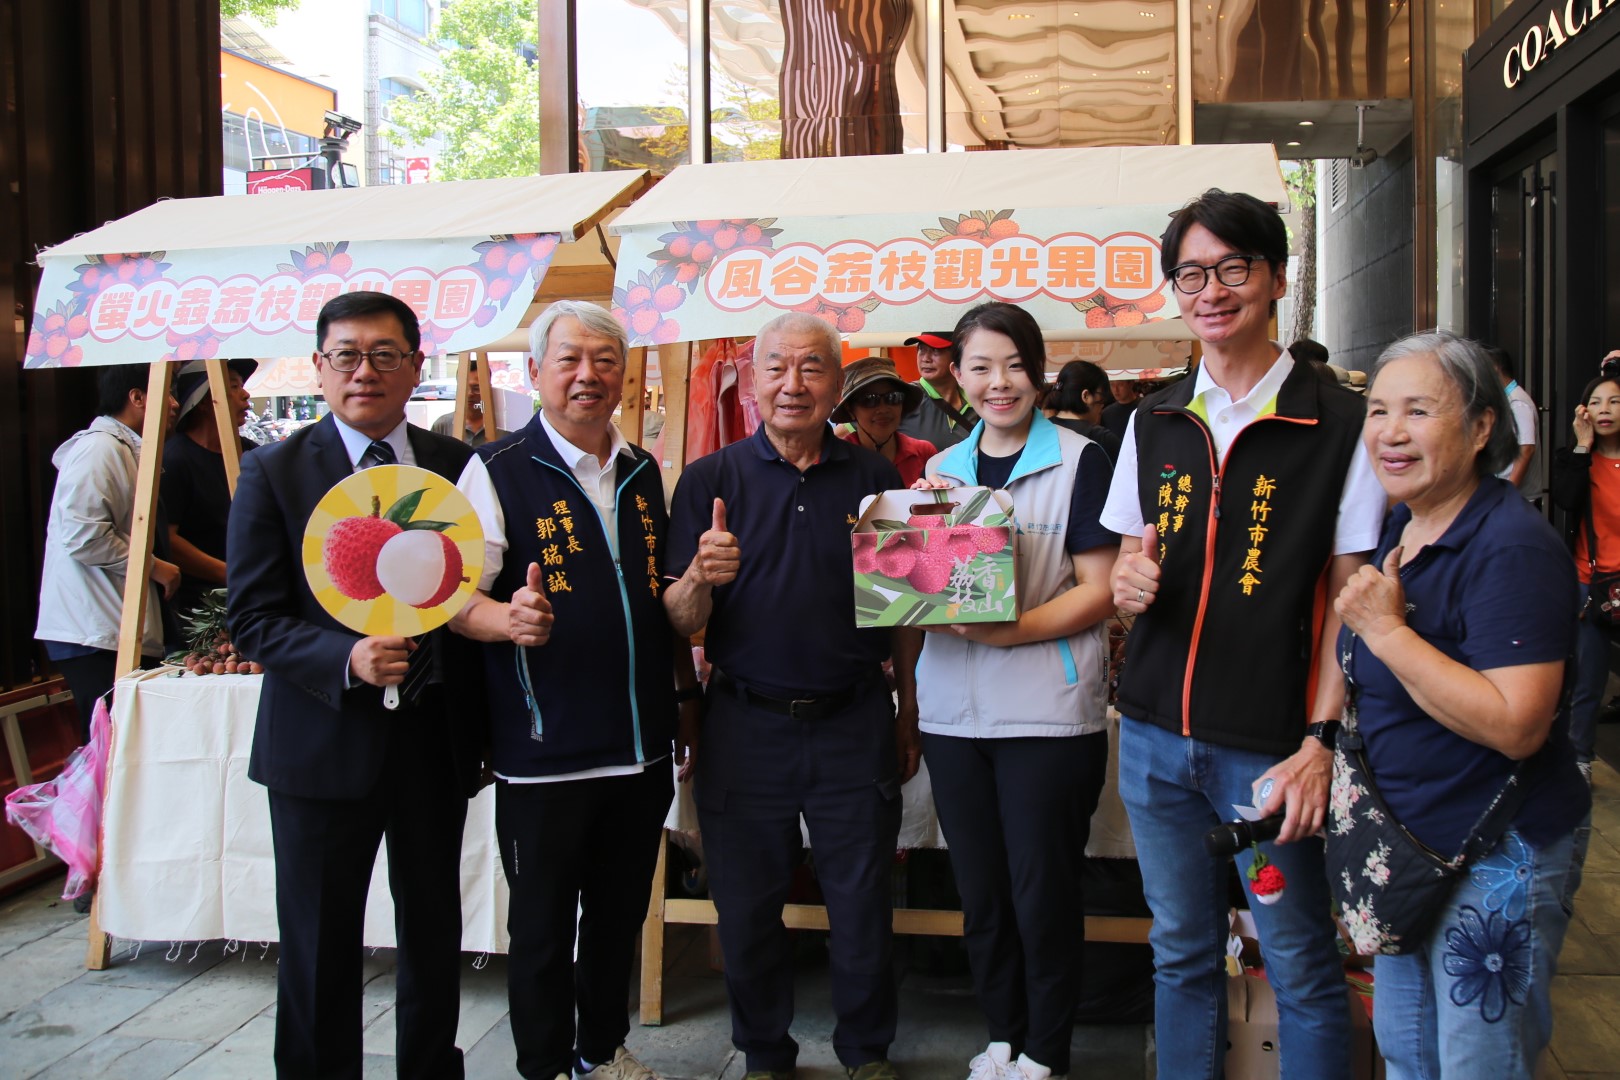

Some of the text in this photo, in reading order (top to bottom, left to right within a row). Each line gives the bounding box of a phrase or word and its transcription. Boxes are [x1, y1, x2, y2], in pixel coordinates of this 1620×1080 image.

[717, 243, 1153, 299] 風谷荔枝觀光果園
[552, 500, 583, 554] 理事長
[1173, 474, 1193, 533] 總幹事
[1238, 474, 1276, 596] 新竹市農會
[536, 517, 572, 593] 郭瑞誠
[635, 494, 660, 598] 新竹市農會
